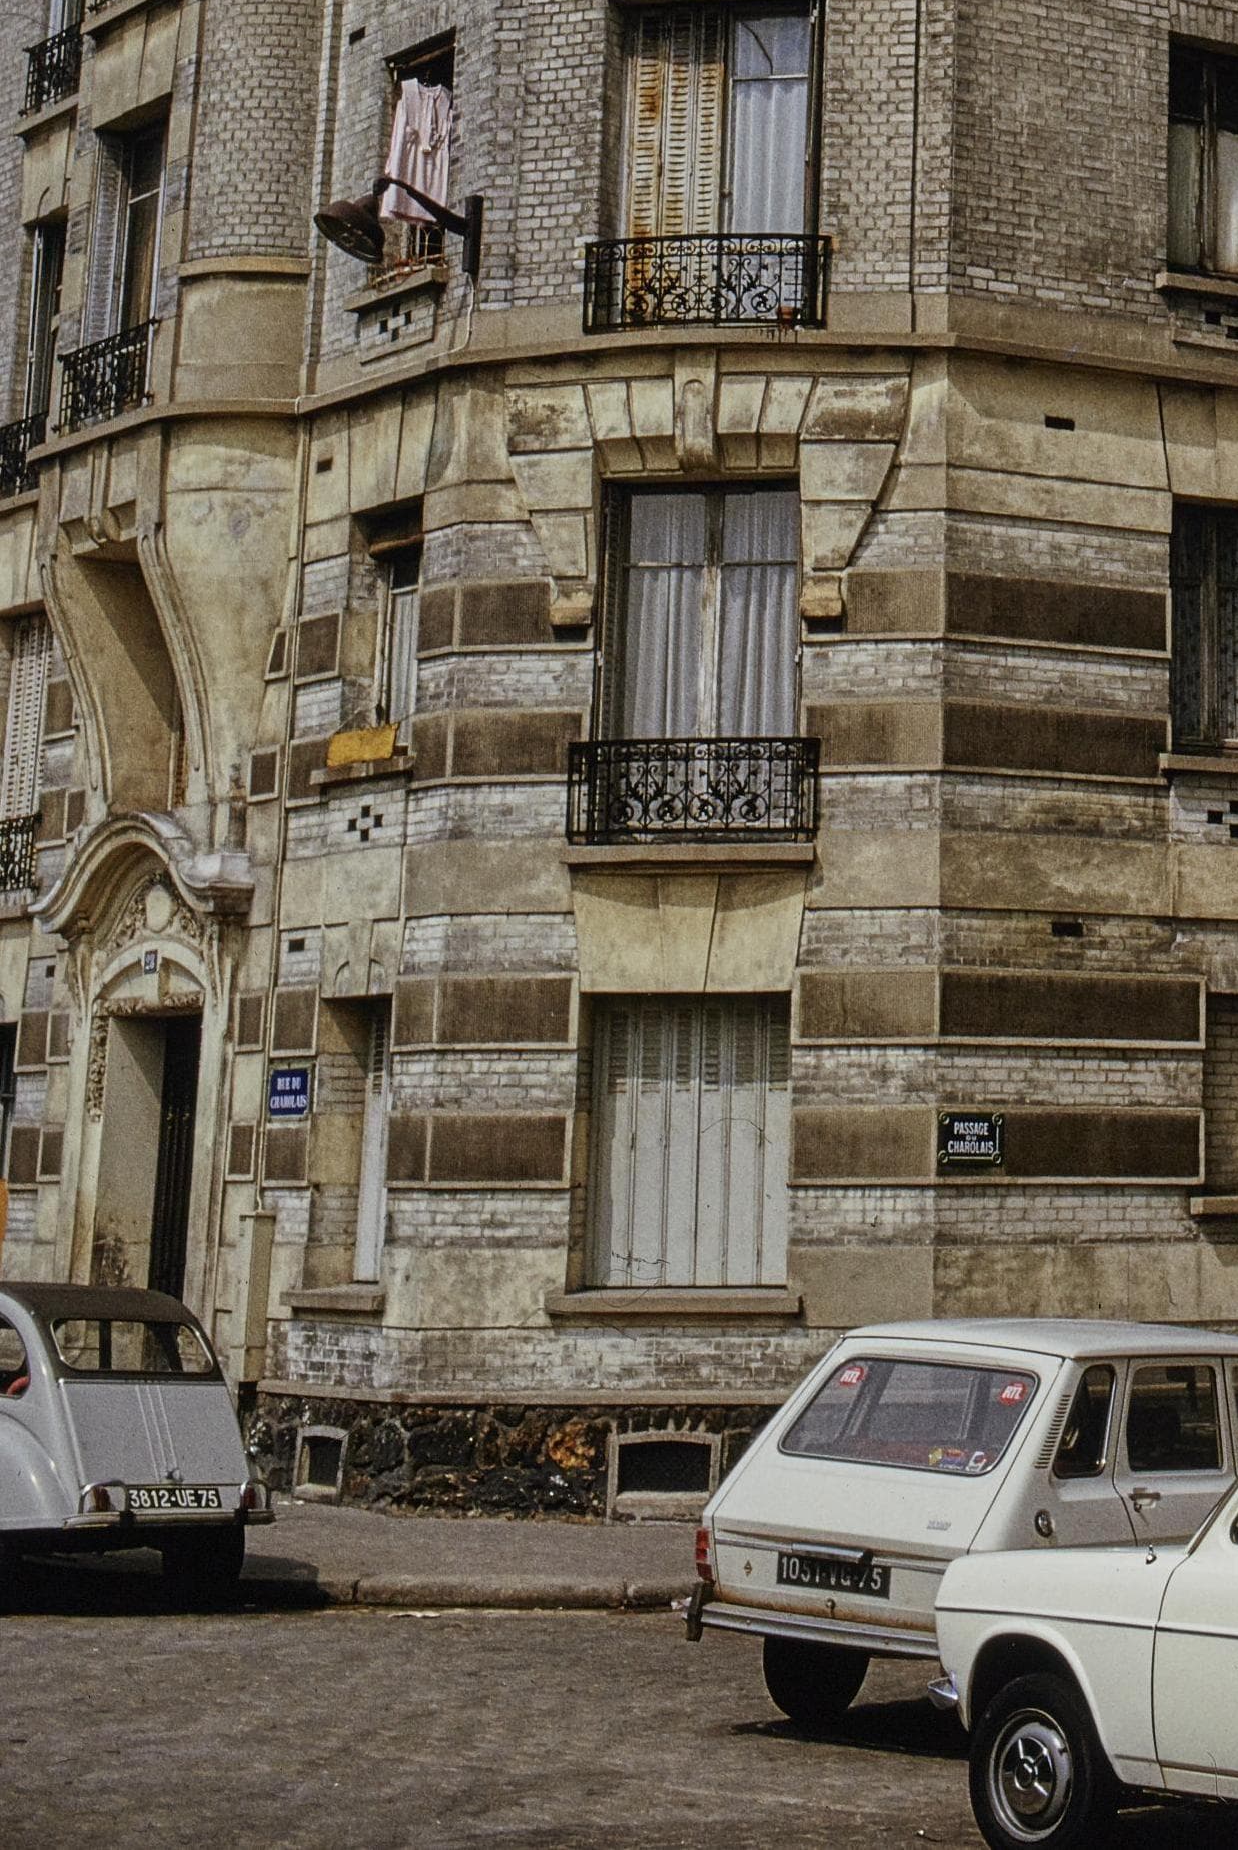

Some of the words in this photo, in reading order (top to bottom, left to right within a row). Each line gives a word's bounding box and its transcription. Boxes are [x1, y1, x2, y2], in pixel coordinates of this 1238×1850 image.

[953, 1122, 989, 1135] PASSAGE
[947, 1140, 994, 1153] CHAROLAIS
[1001, 1386, 1022, 1400] RTL
